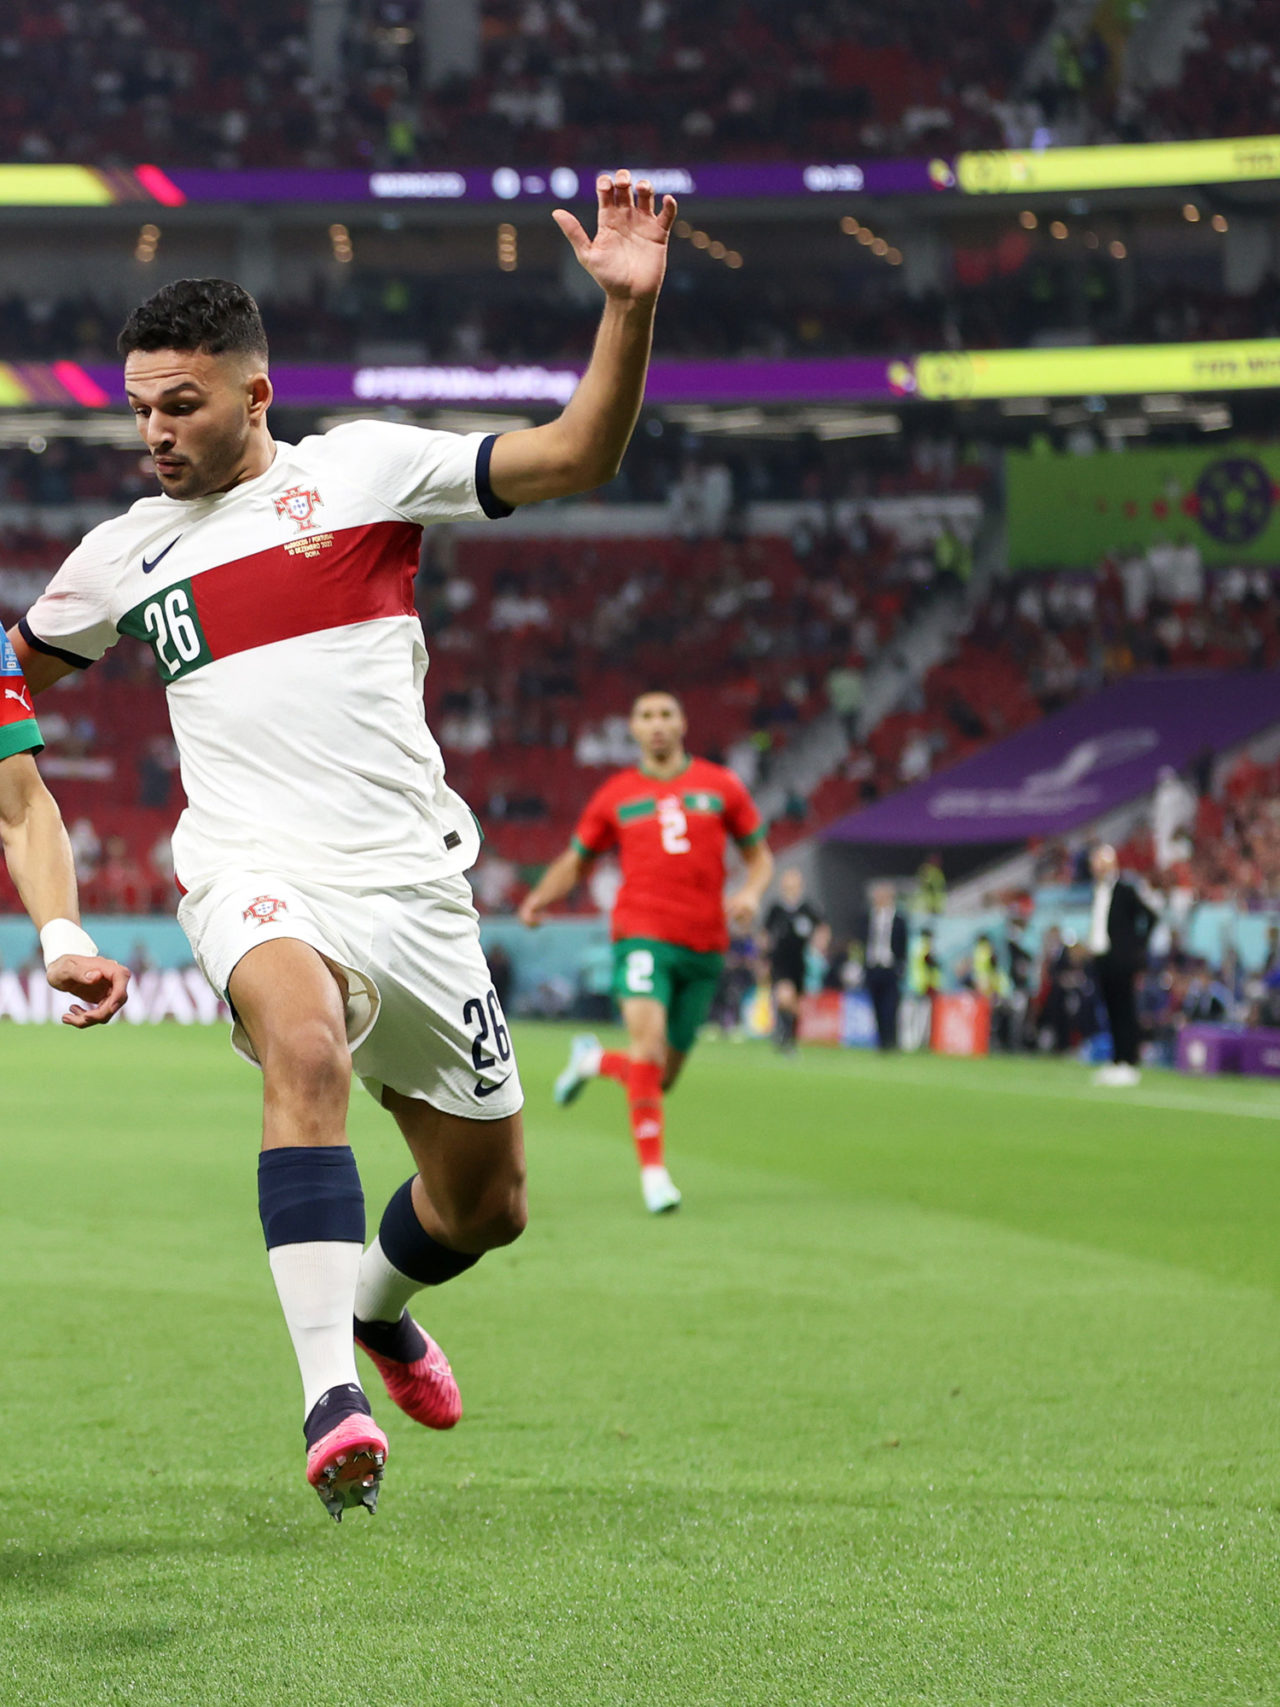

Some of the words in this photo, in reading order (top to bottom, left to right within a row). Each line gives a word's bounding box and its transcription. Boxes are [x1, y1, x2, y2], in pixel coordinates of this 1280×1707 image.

[143, 587, 201, 676] 26
[661, 810, 691, 855] 2
[626, 949, 654, 993] 2
[463, 989, 511, 1071] 26
